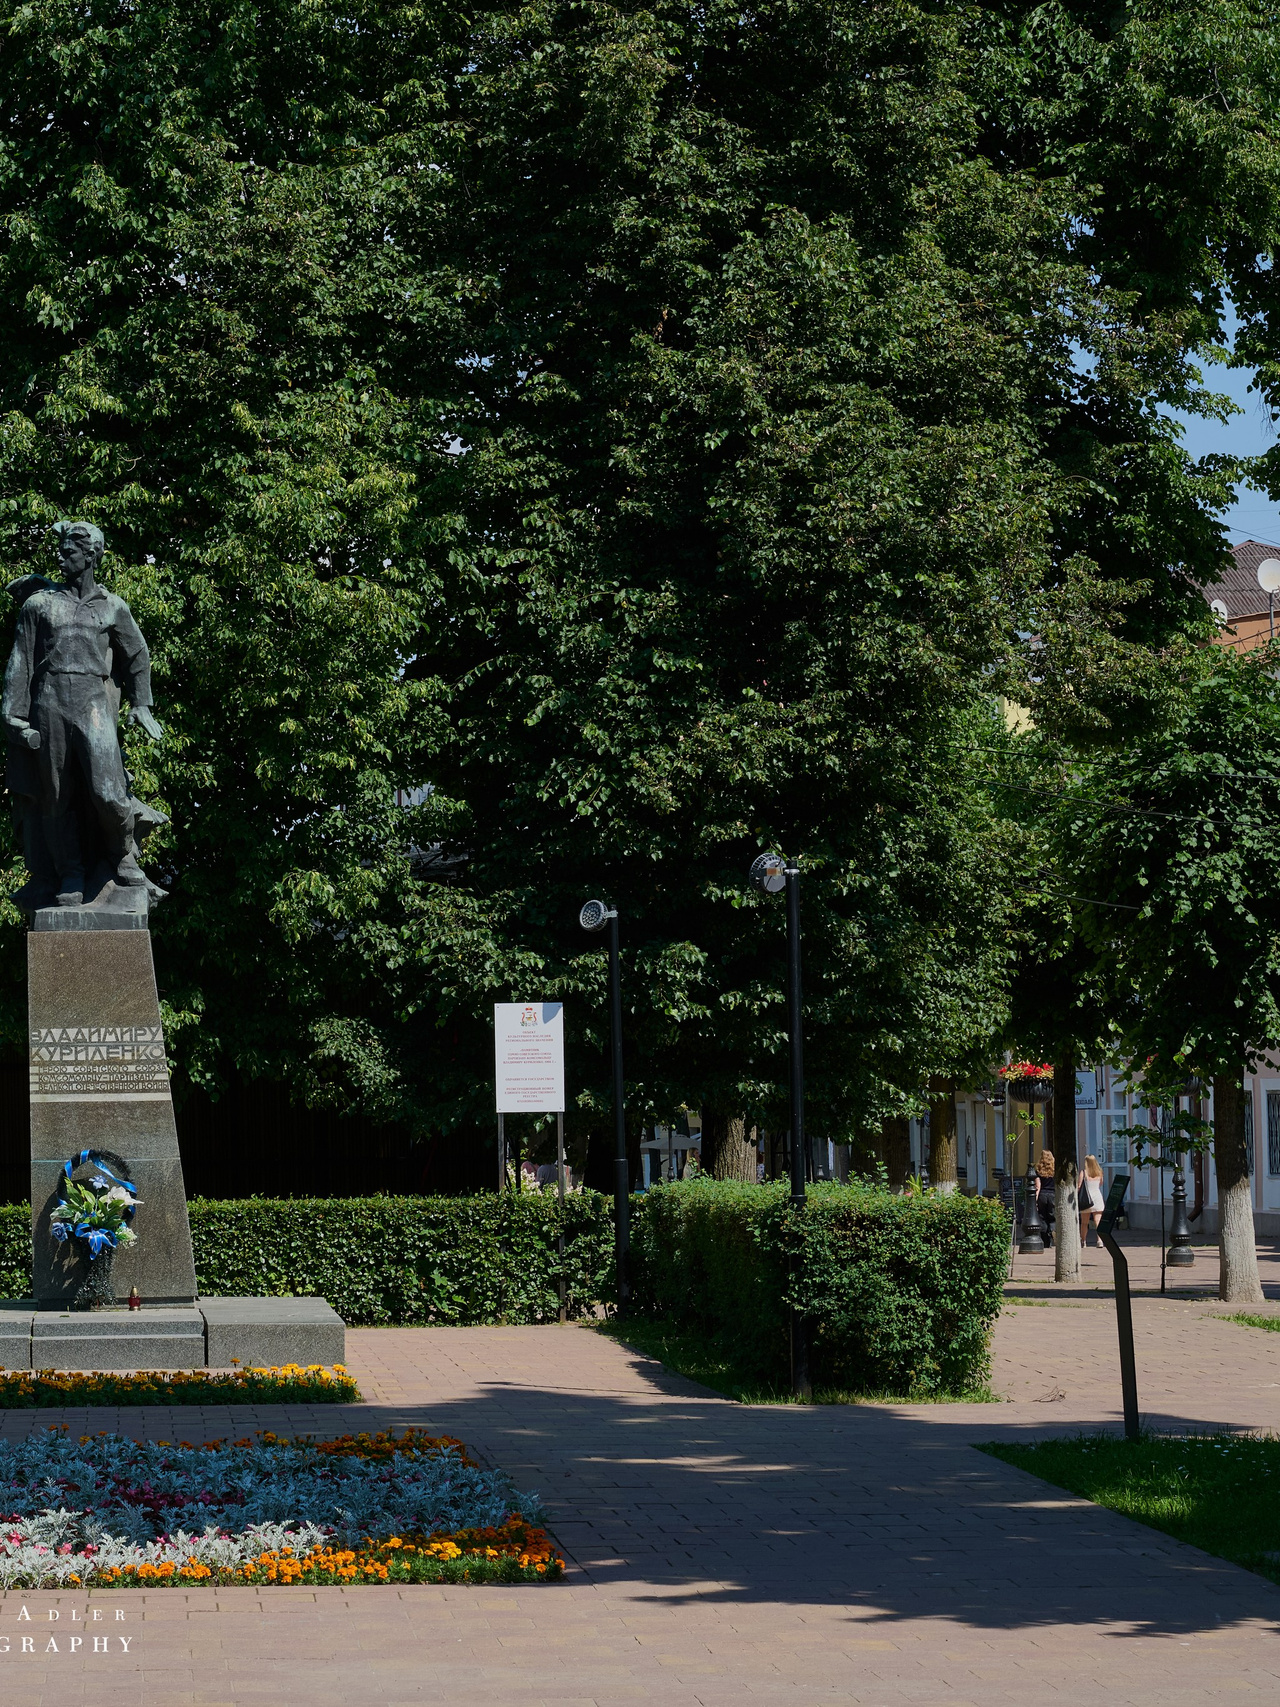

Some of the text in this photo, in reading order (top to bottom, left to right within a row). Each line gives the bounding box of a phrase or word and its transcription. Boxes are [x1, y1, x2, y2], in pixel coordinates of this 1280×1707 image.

[30, 1026, 160, 1043] ВЛАДИМИРУ
[30, 1045, 165, 1061] КУРИЛЕНКО
[39, 1064, 166, 1073] ГЕРОЮ СОВЕТСКОГО СОЮЗА
